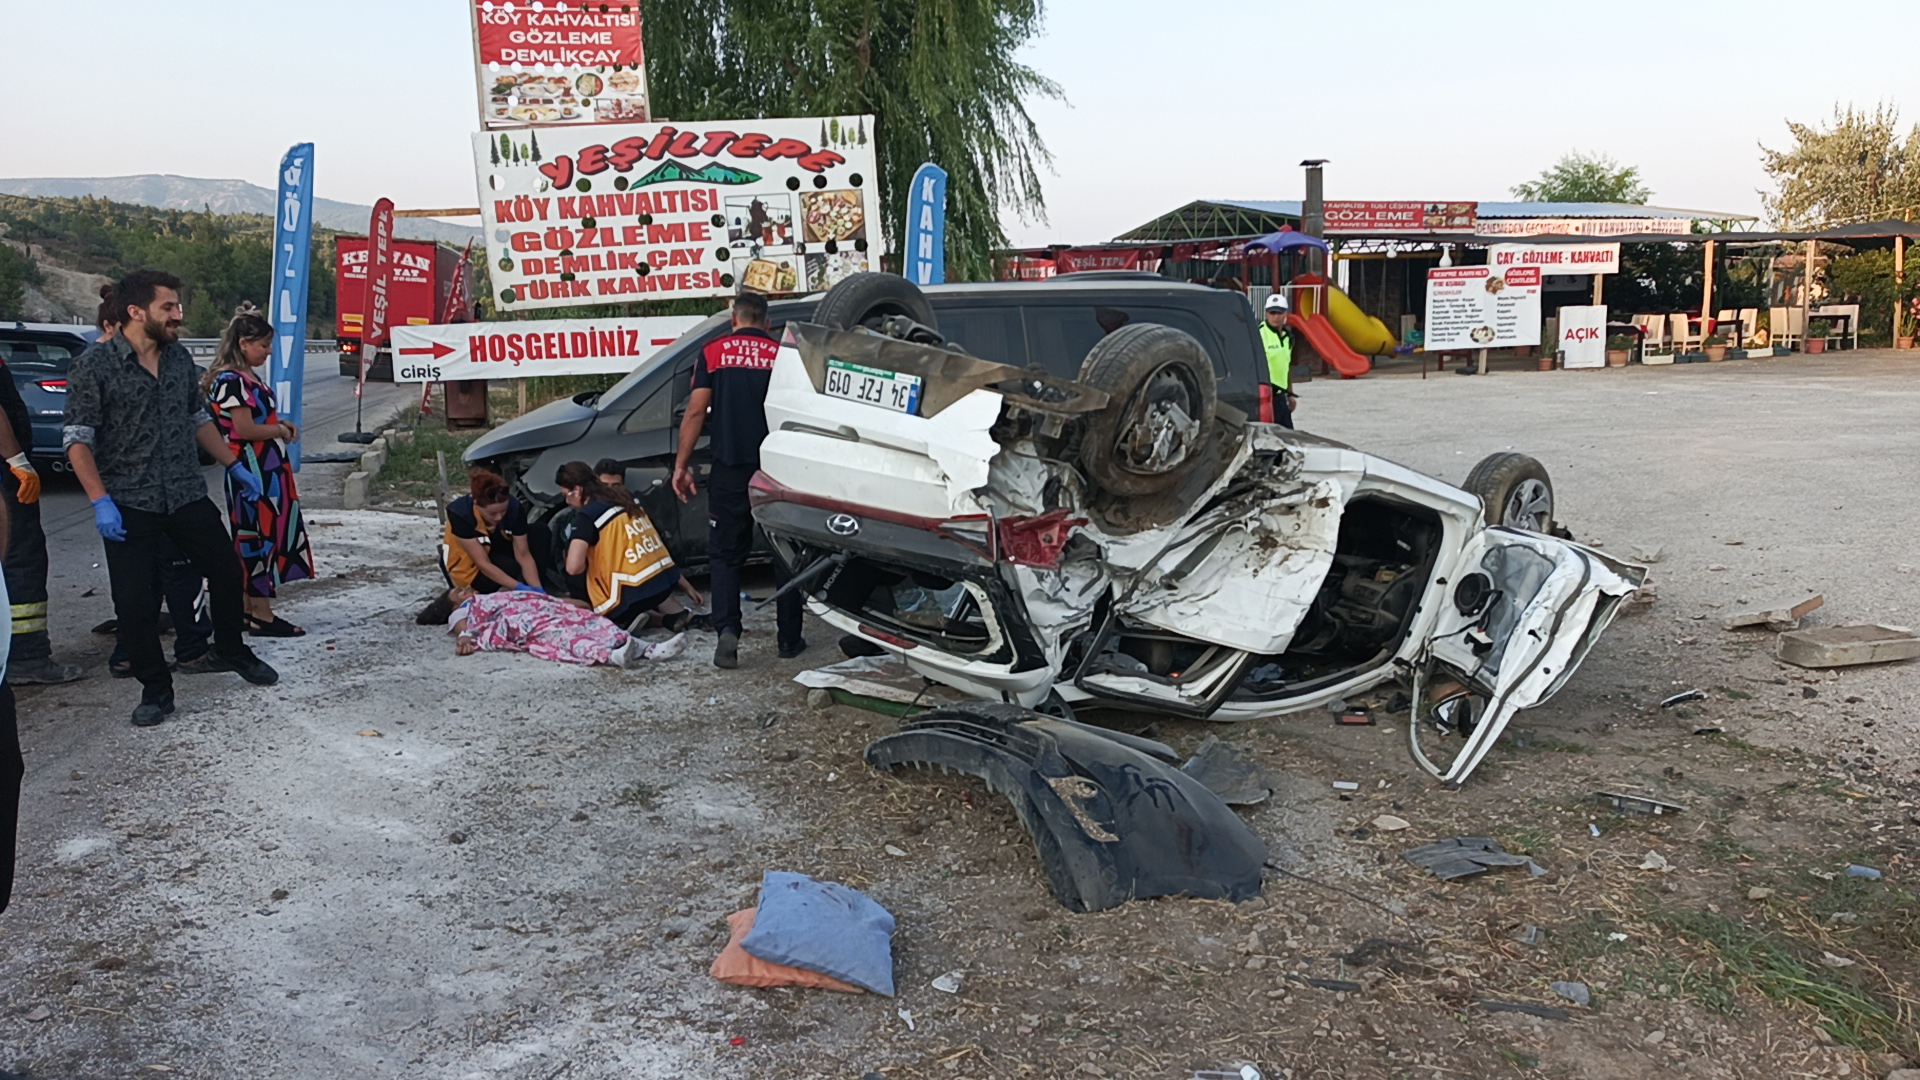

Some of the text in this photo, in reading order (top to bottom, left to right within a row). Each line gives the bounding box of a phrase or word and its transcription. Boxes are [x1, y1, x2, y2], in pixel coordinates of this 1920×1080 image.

[482, 10, 636, 26] KÖY KAHVALTISI
[509, 28, 612, 44] GÖZLEME
[539, 126, 846, 190] YEŞİLTEPE
[494, 188, 718, 223] KÖY KAHVALTISI
[1324, 209, 1414, 221] GÖZLEME
[511, 221, 711, 252] GÖZLEME
[342, 250, 430, 271] KEAN
[521, 248, 705, 276] DEMLİK ÇAY
[1100, 256, 1125, 267] TEPE
[1522, 249, 1562, 264] GÖZLEME
[1570, 250, 1613, 264] KAHVALTI
[510, 268, 723, 301] TÜRK KAHVESİ
[371, 274, 389, 338] YEŞİL
[1564, 327, 1599, 343] AÇIK
[468, 325, 640, 366] HOŞGELDİNİZ
[722, 340, 777, 354] BURDUR
[738, 345, 759, 357] 112
[401, 364, 441, 381] GİRİŞ
[828, 370, 908, 409] 34 FZF 019
